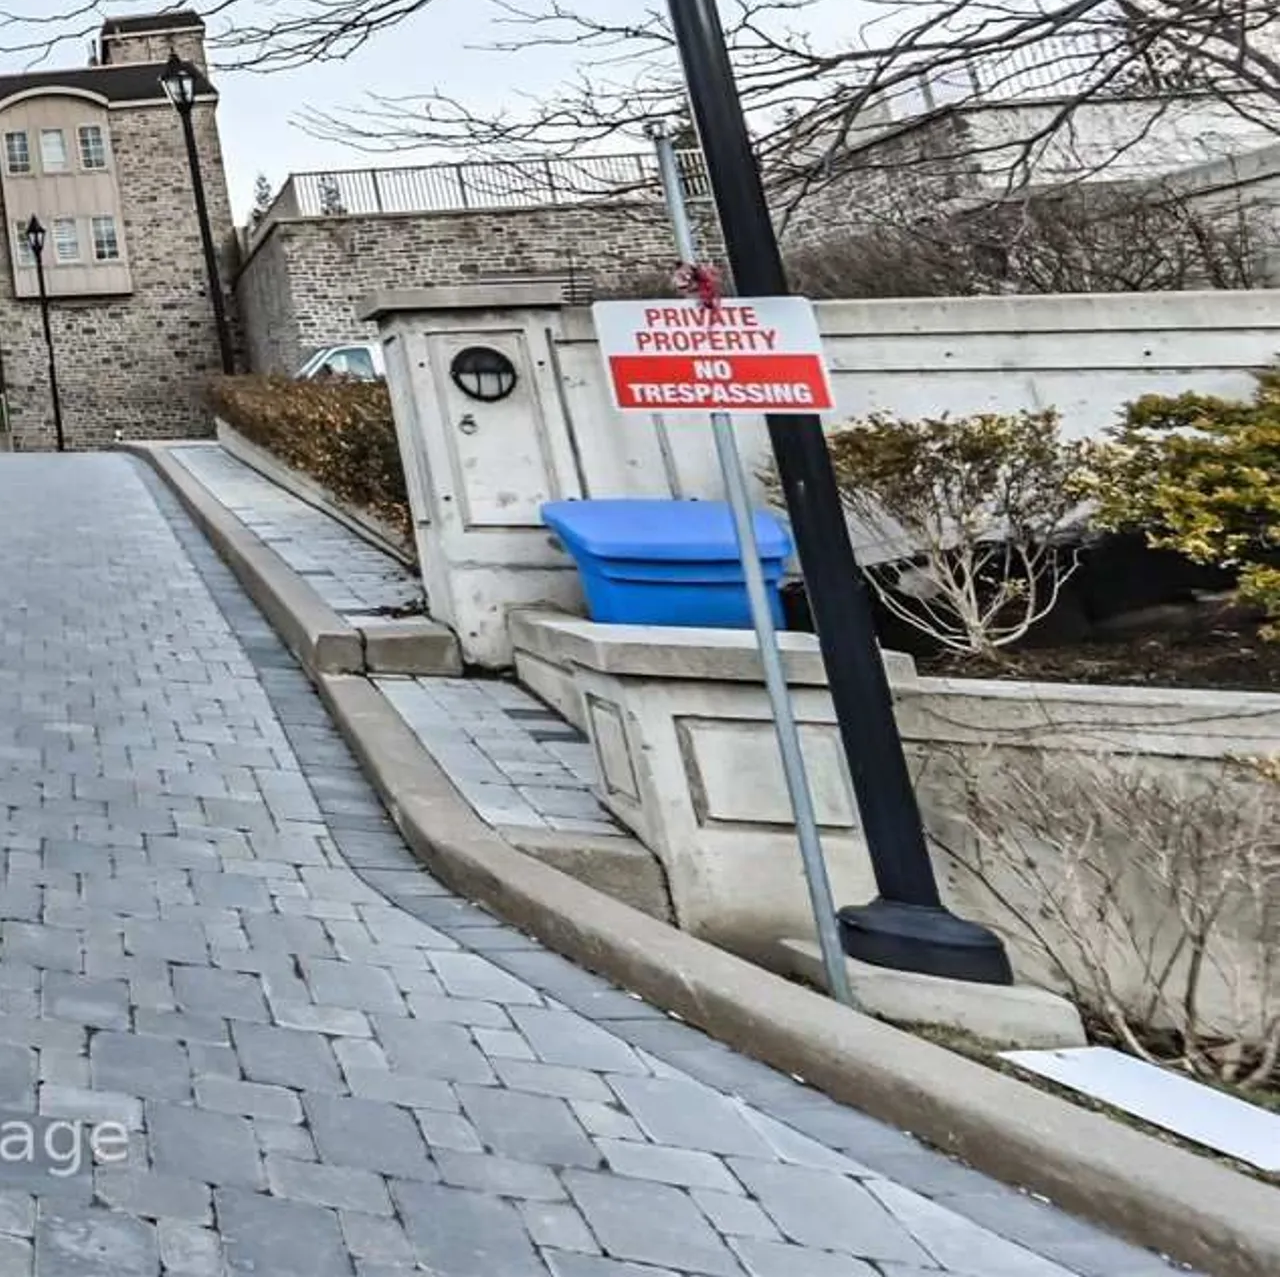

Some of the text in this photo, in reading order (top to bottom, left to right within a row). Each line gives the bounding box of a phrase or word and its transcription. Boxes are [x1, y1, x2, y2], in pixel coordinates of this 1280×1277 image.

[645, 306, 758, 328] PRIVATE
[636, 330, 775, 352] PROPERTY
[693, 360, 732, 380] NO
[627, 383, 813, 405] TRESPASSING
